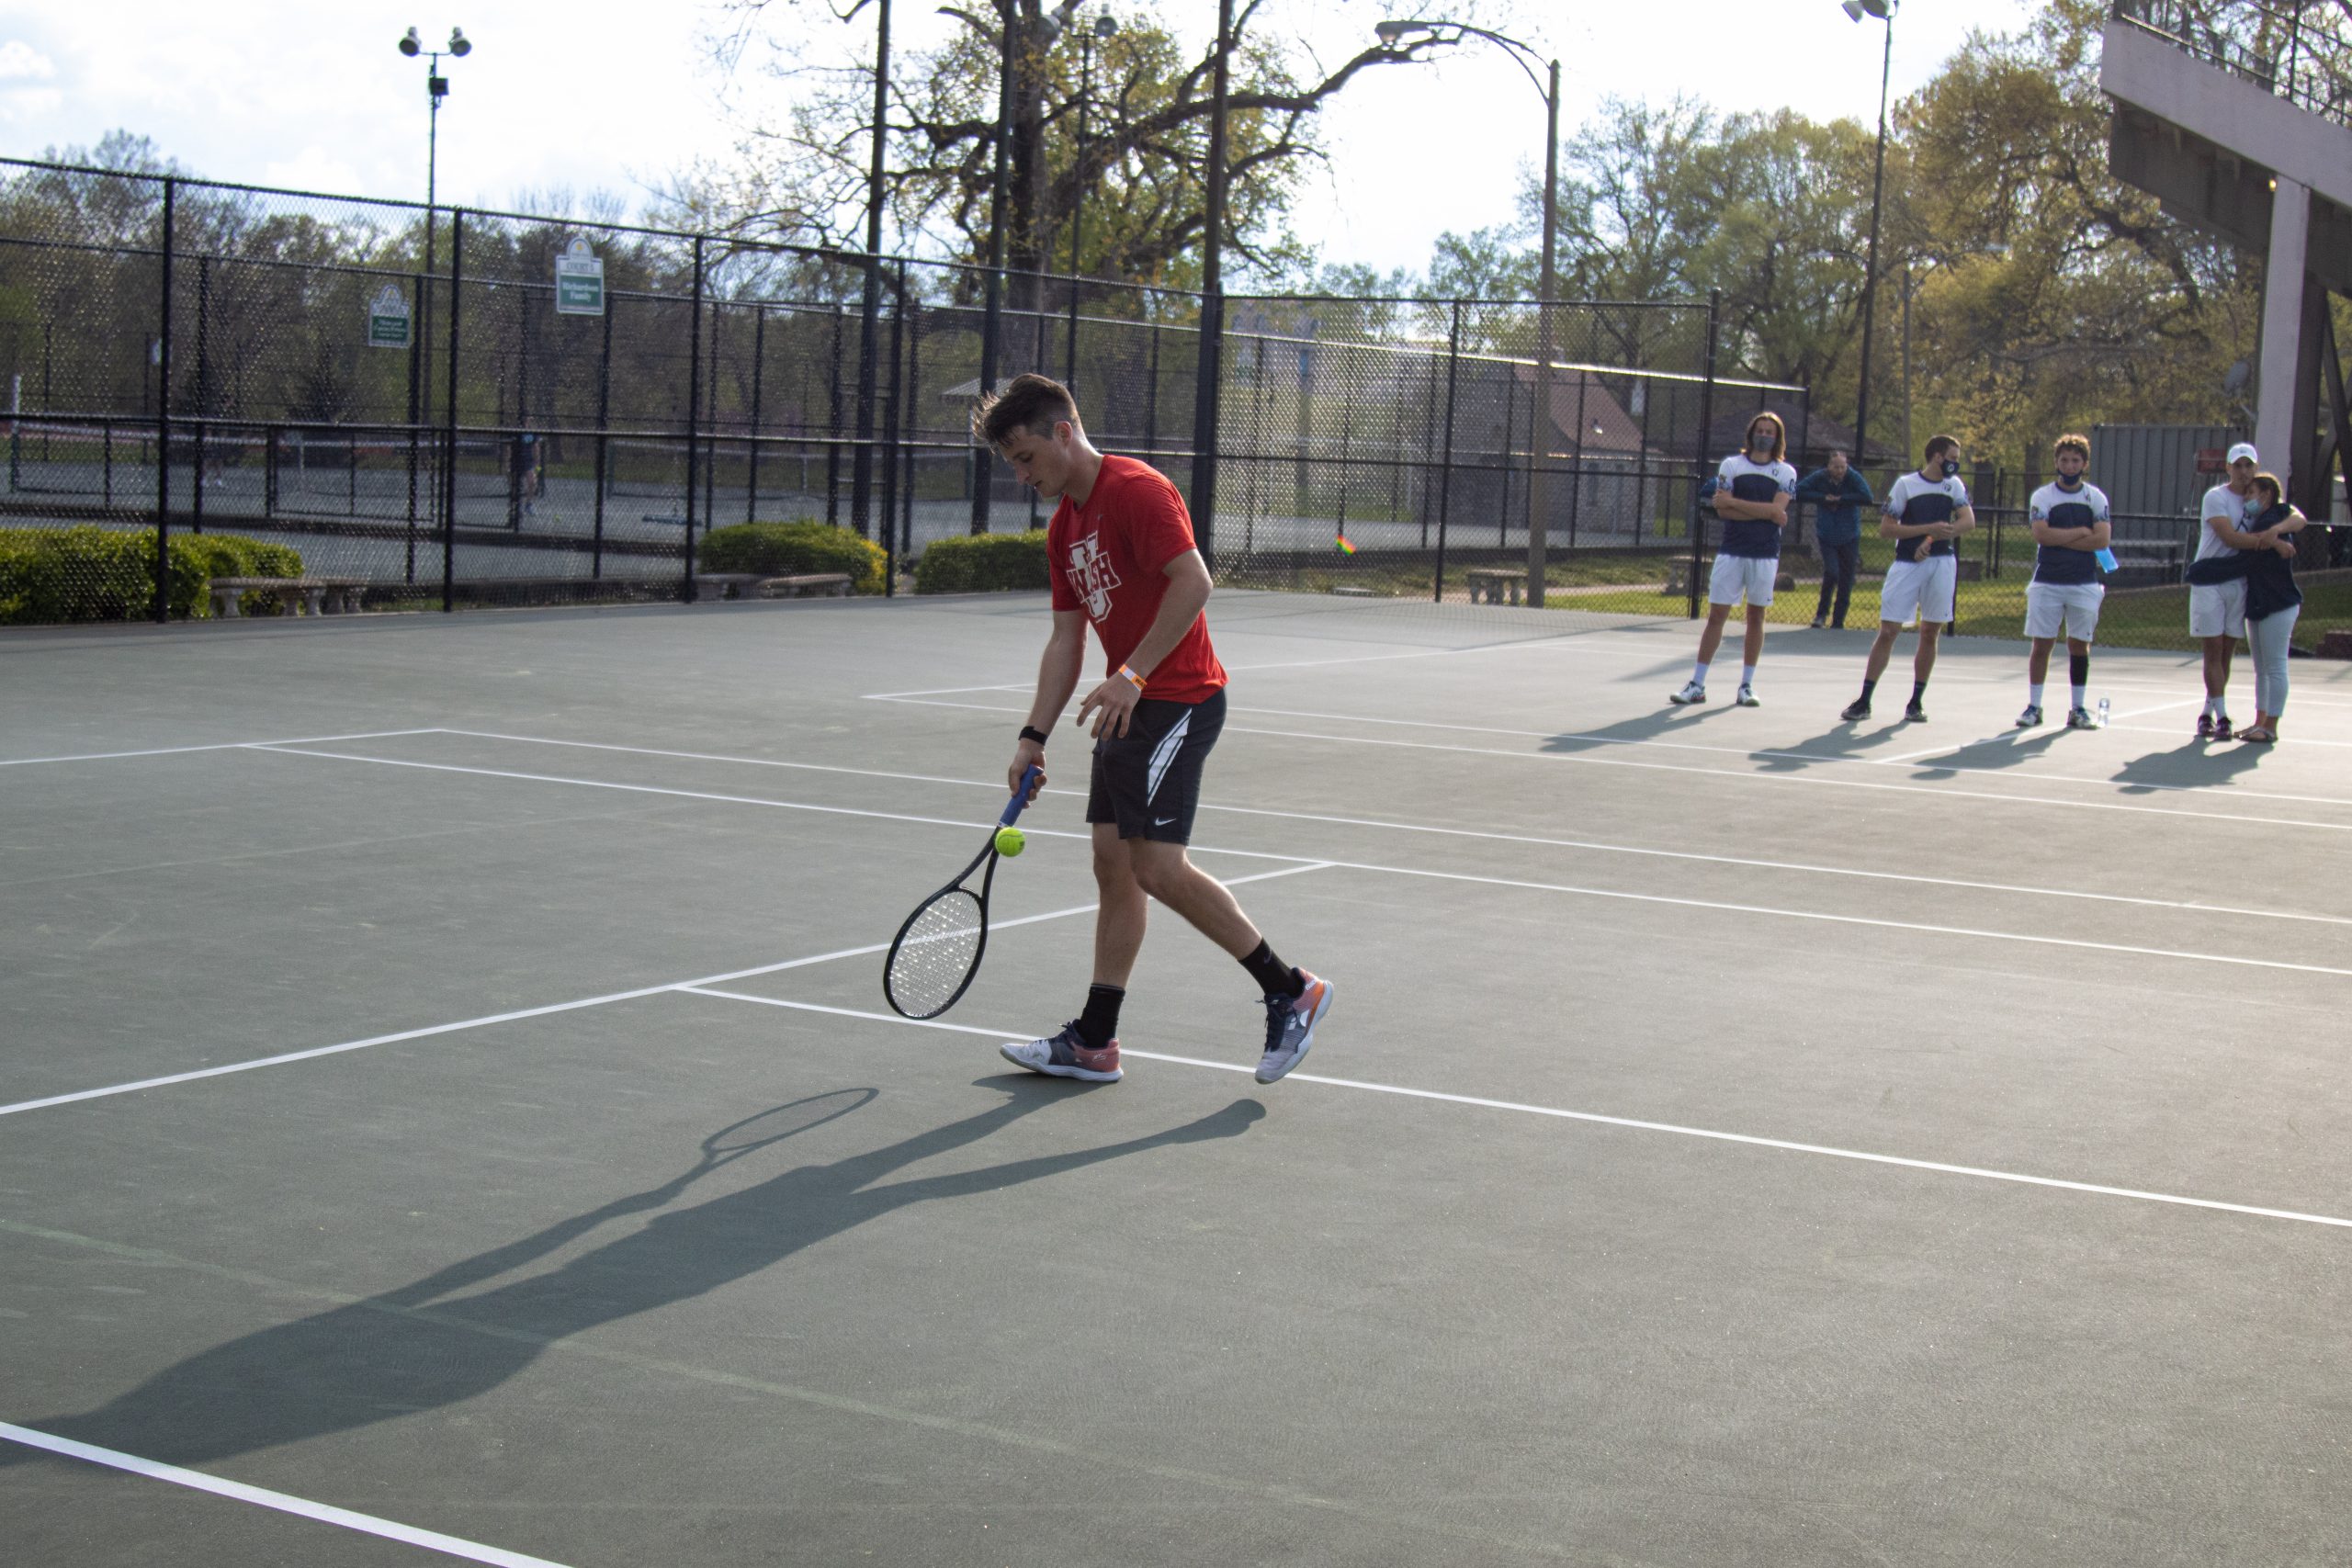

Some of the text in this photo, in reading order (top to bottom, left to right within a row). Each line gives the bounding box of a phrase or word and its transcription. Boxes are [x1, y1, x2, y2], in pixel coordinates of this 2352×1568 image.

[566, 262, 588, 272] COURT
[570, 291, 592, 302] Family
[1066, 551, 1122, 604] WSH
